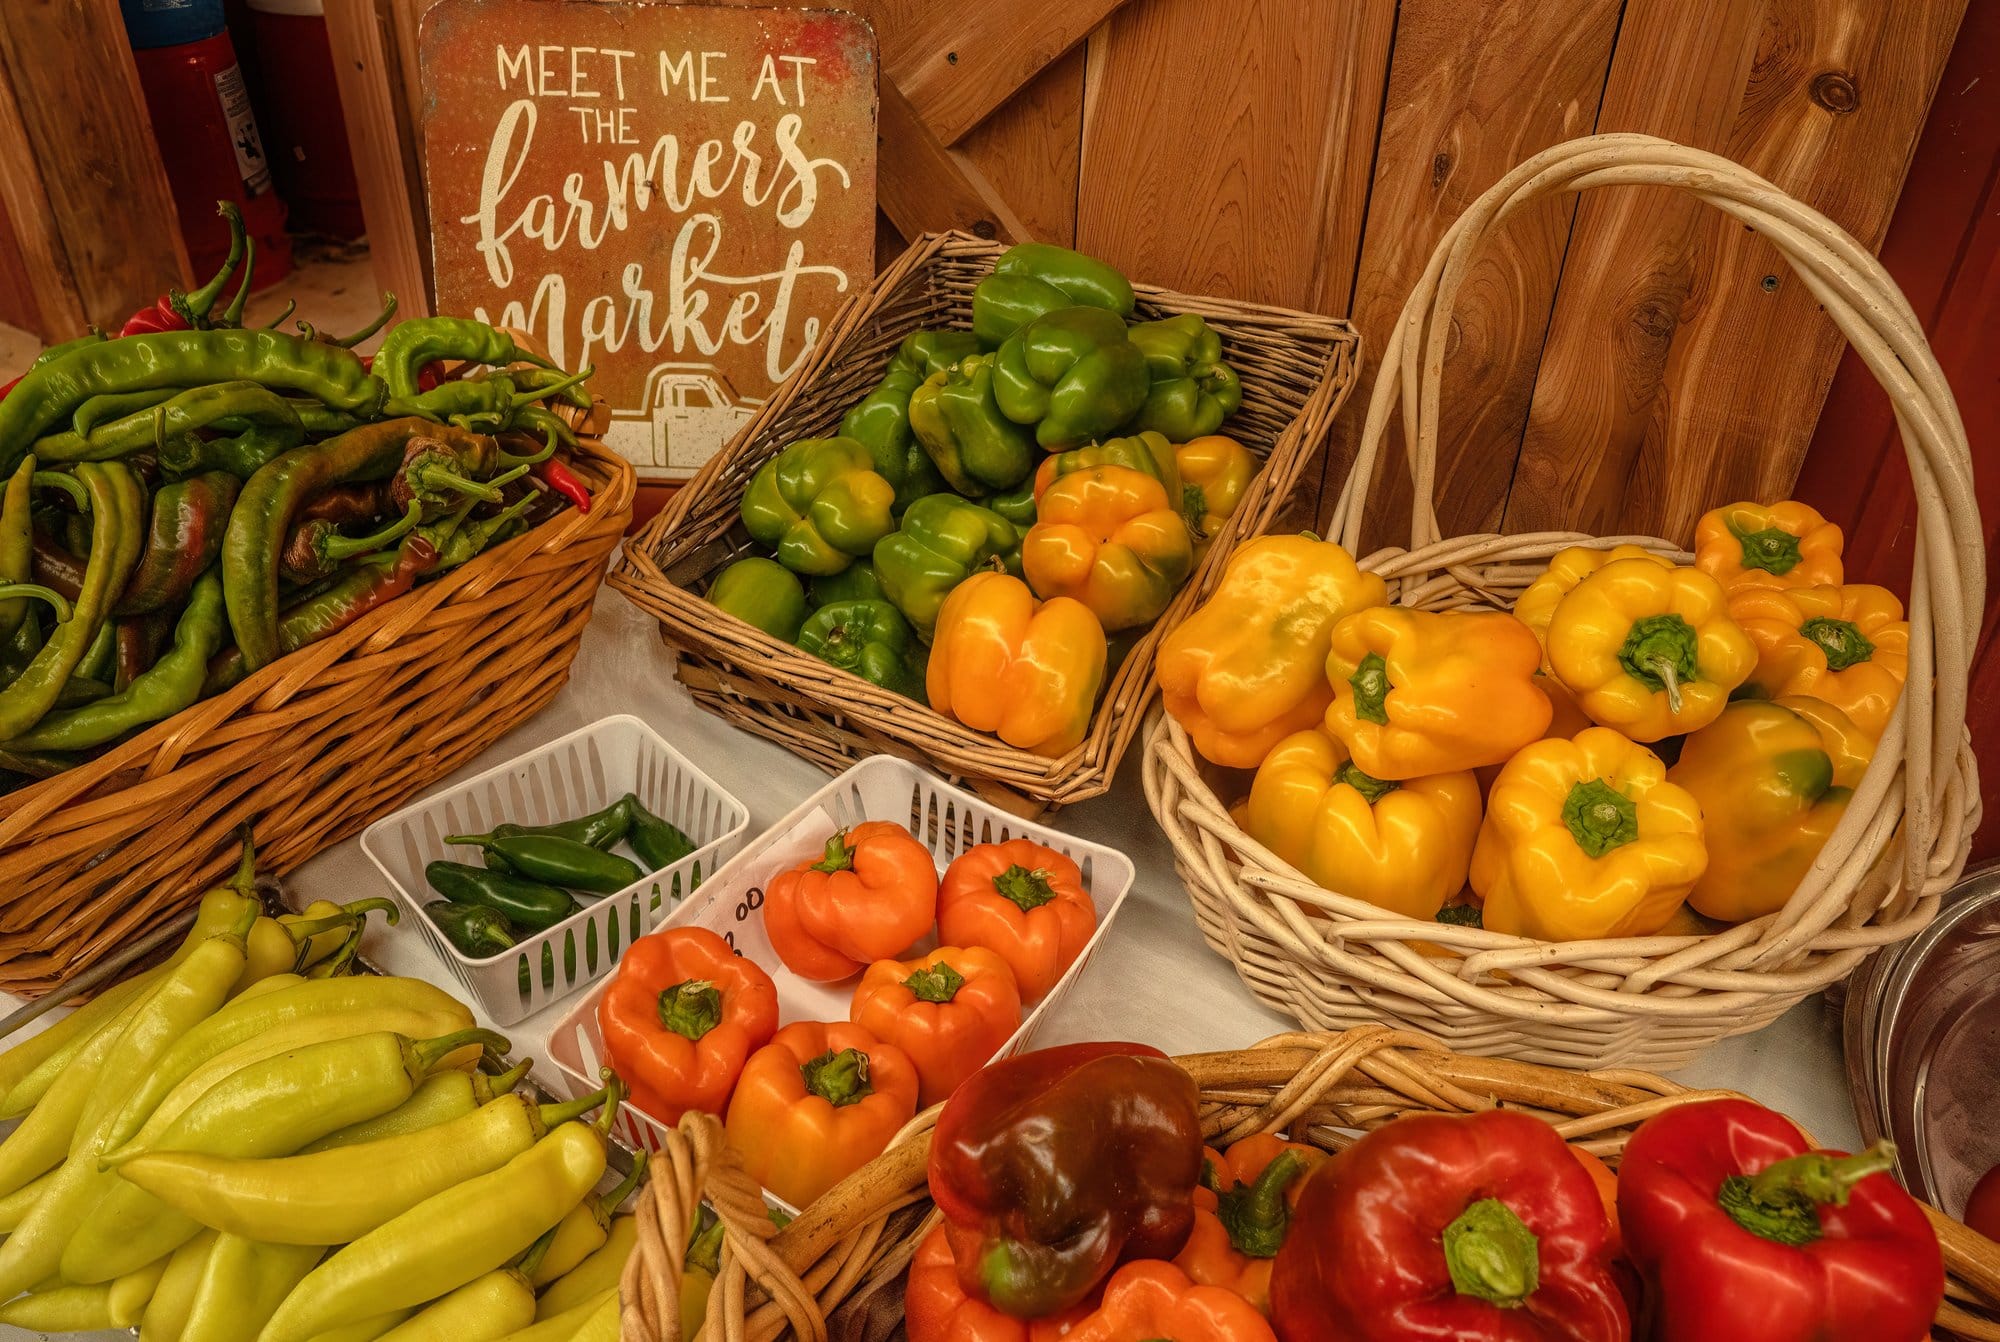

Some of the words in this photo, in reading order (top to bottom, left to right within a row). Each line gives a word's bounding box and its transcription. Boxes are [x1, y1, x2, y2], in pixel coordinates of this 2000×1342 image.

[497, 44, 635, 100] MEET
[660, 50, 729, 102] ME
[752, 54, 817, 106] AT
[569, 107, 640, 144] THE
[460, 99, 851, 288] farmers
